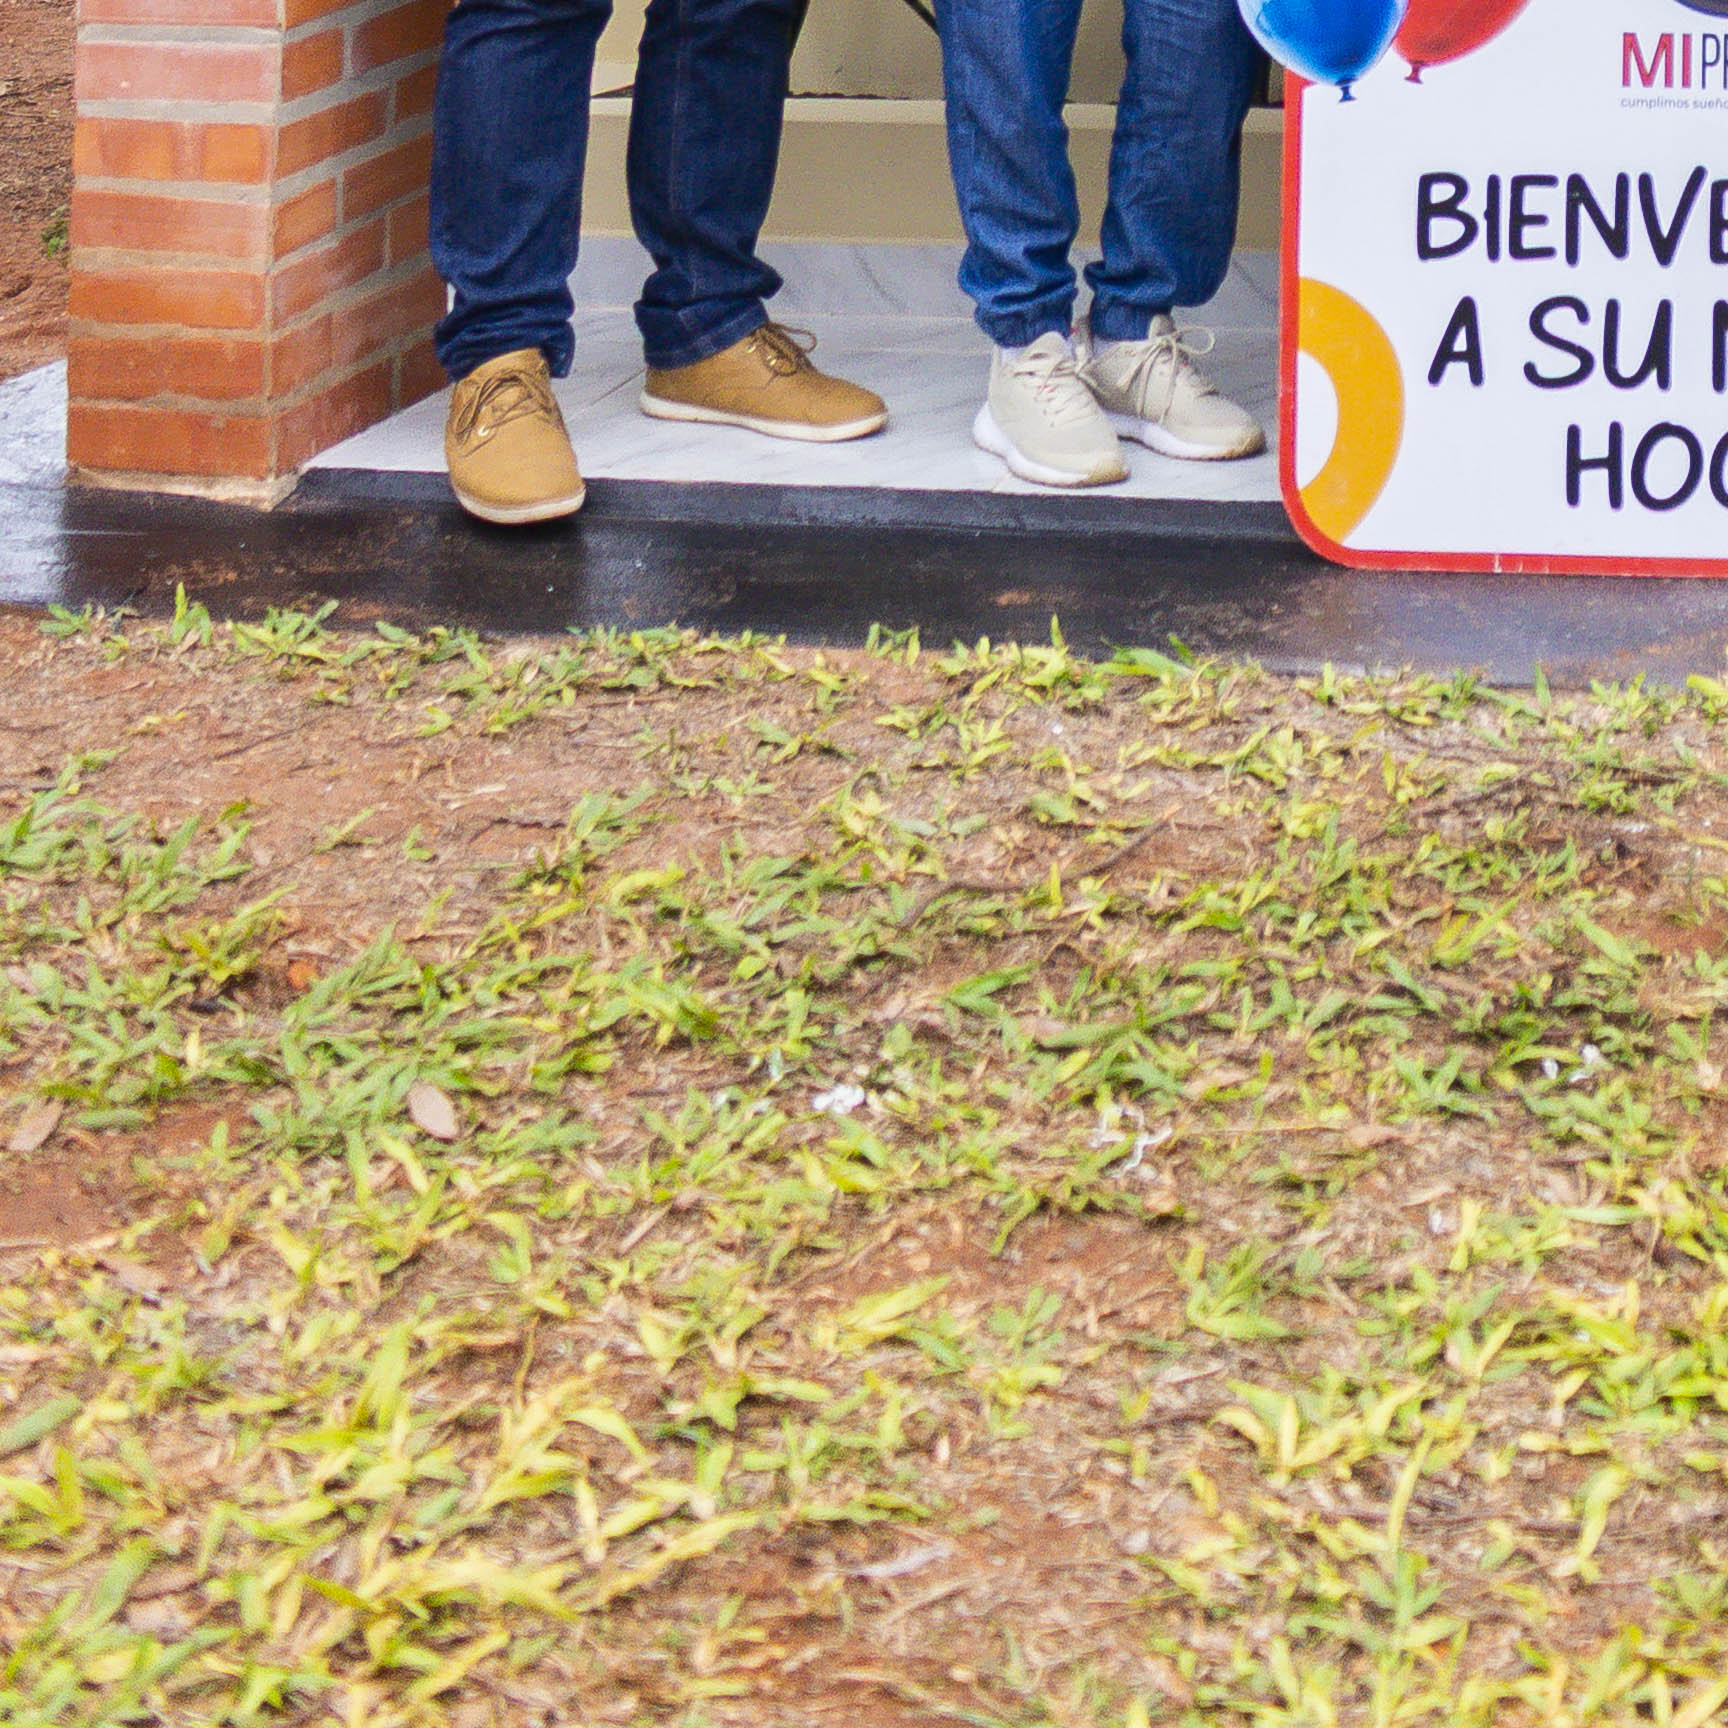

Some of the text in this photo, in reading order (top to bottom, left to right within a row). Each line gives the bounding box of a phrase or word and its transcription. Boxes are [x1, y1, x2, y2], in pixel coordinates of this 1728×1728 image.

[1621, 31, 1692, 89] MI
[1620, 96, 1690, 111] cumplimos
[1426, 295, 1485, 388] A
[1522, 296, 1673, 392] SU
